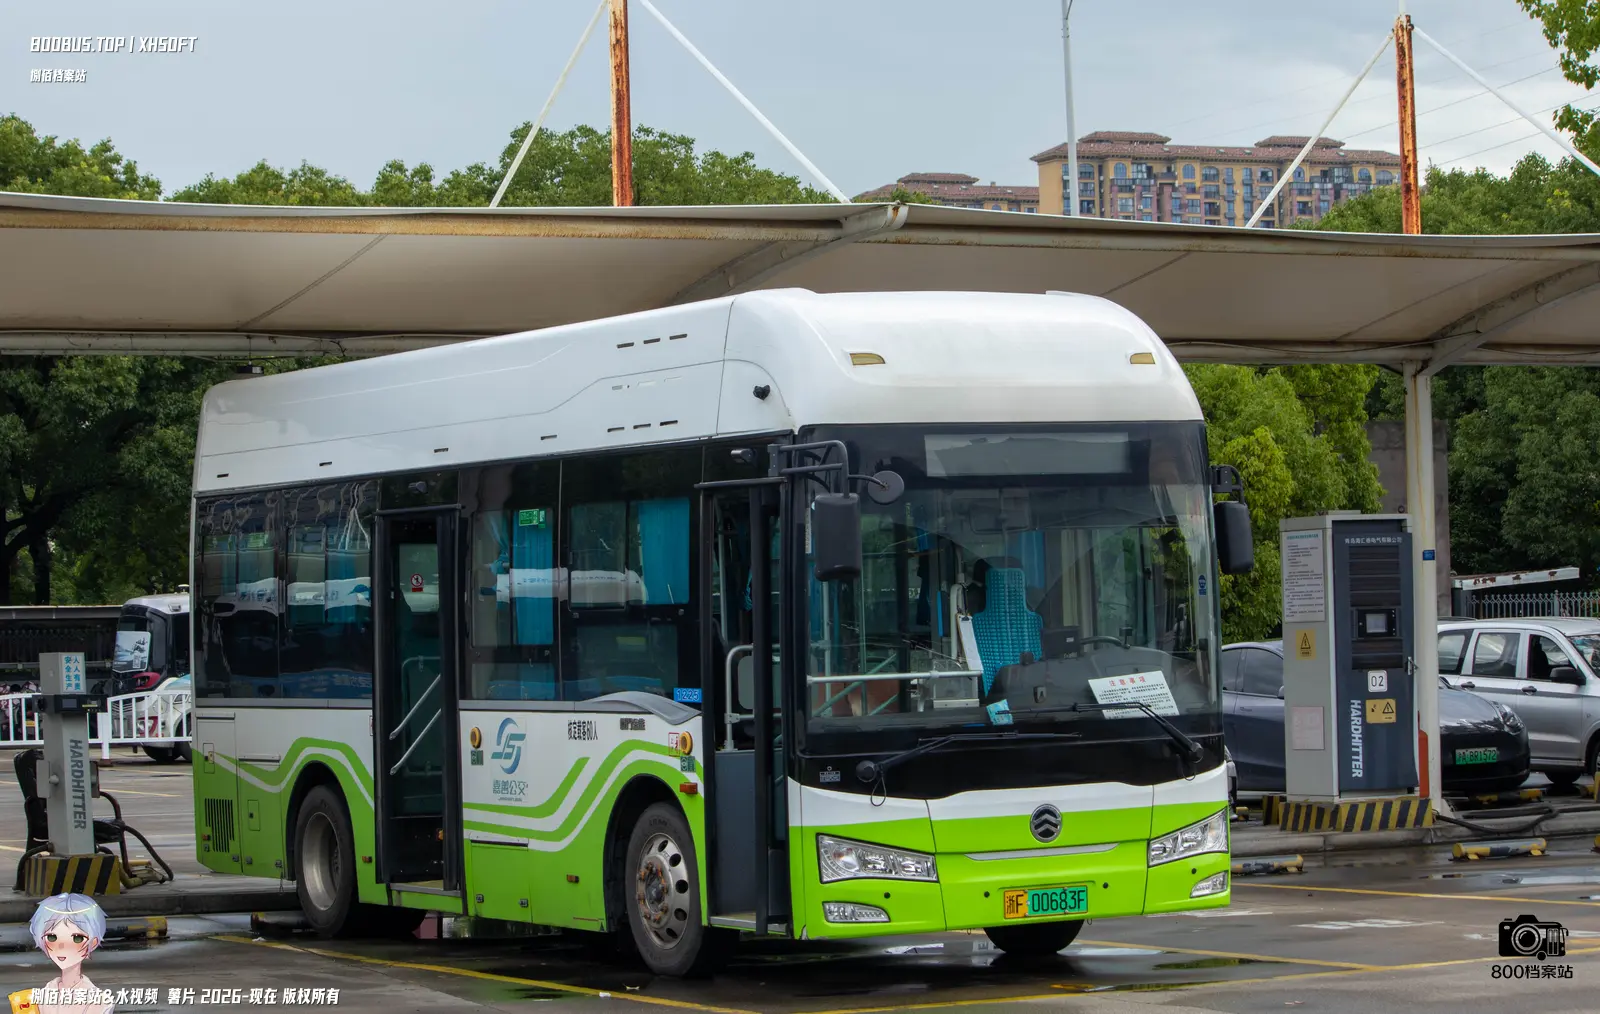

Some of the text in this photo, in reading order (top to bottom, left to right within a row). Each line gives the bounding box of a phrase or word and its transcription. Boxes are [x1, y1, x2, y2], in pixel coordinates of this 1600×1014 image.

[1371, 676, 1385, 687] 02
[676, 689, 700, 701] 1225
[1350, 700, 1364, 778] HARDHITTER
[69, 738, 87, 830] HARDHITTER
[1031, 889, 1086, 912] 00683F
